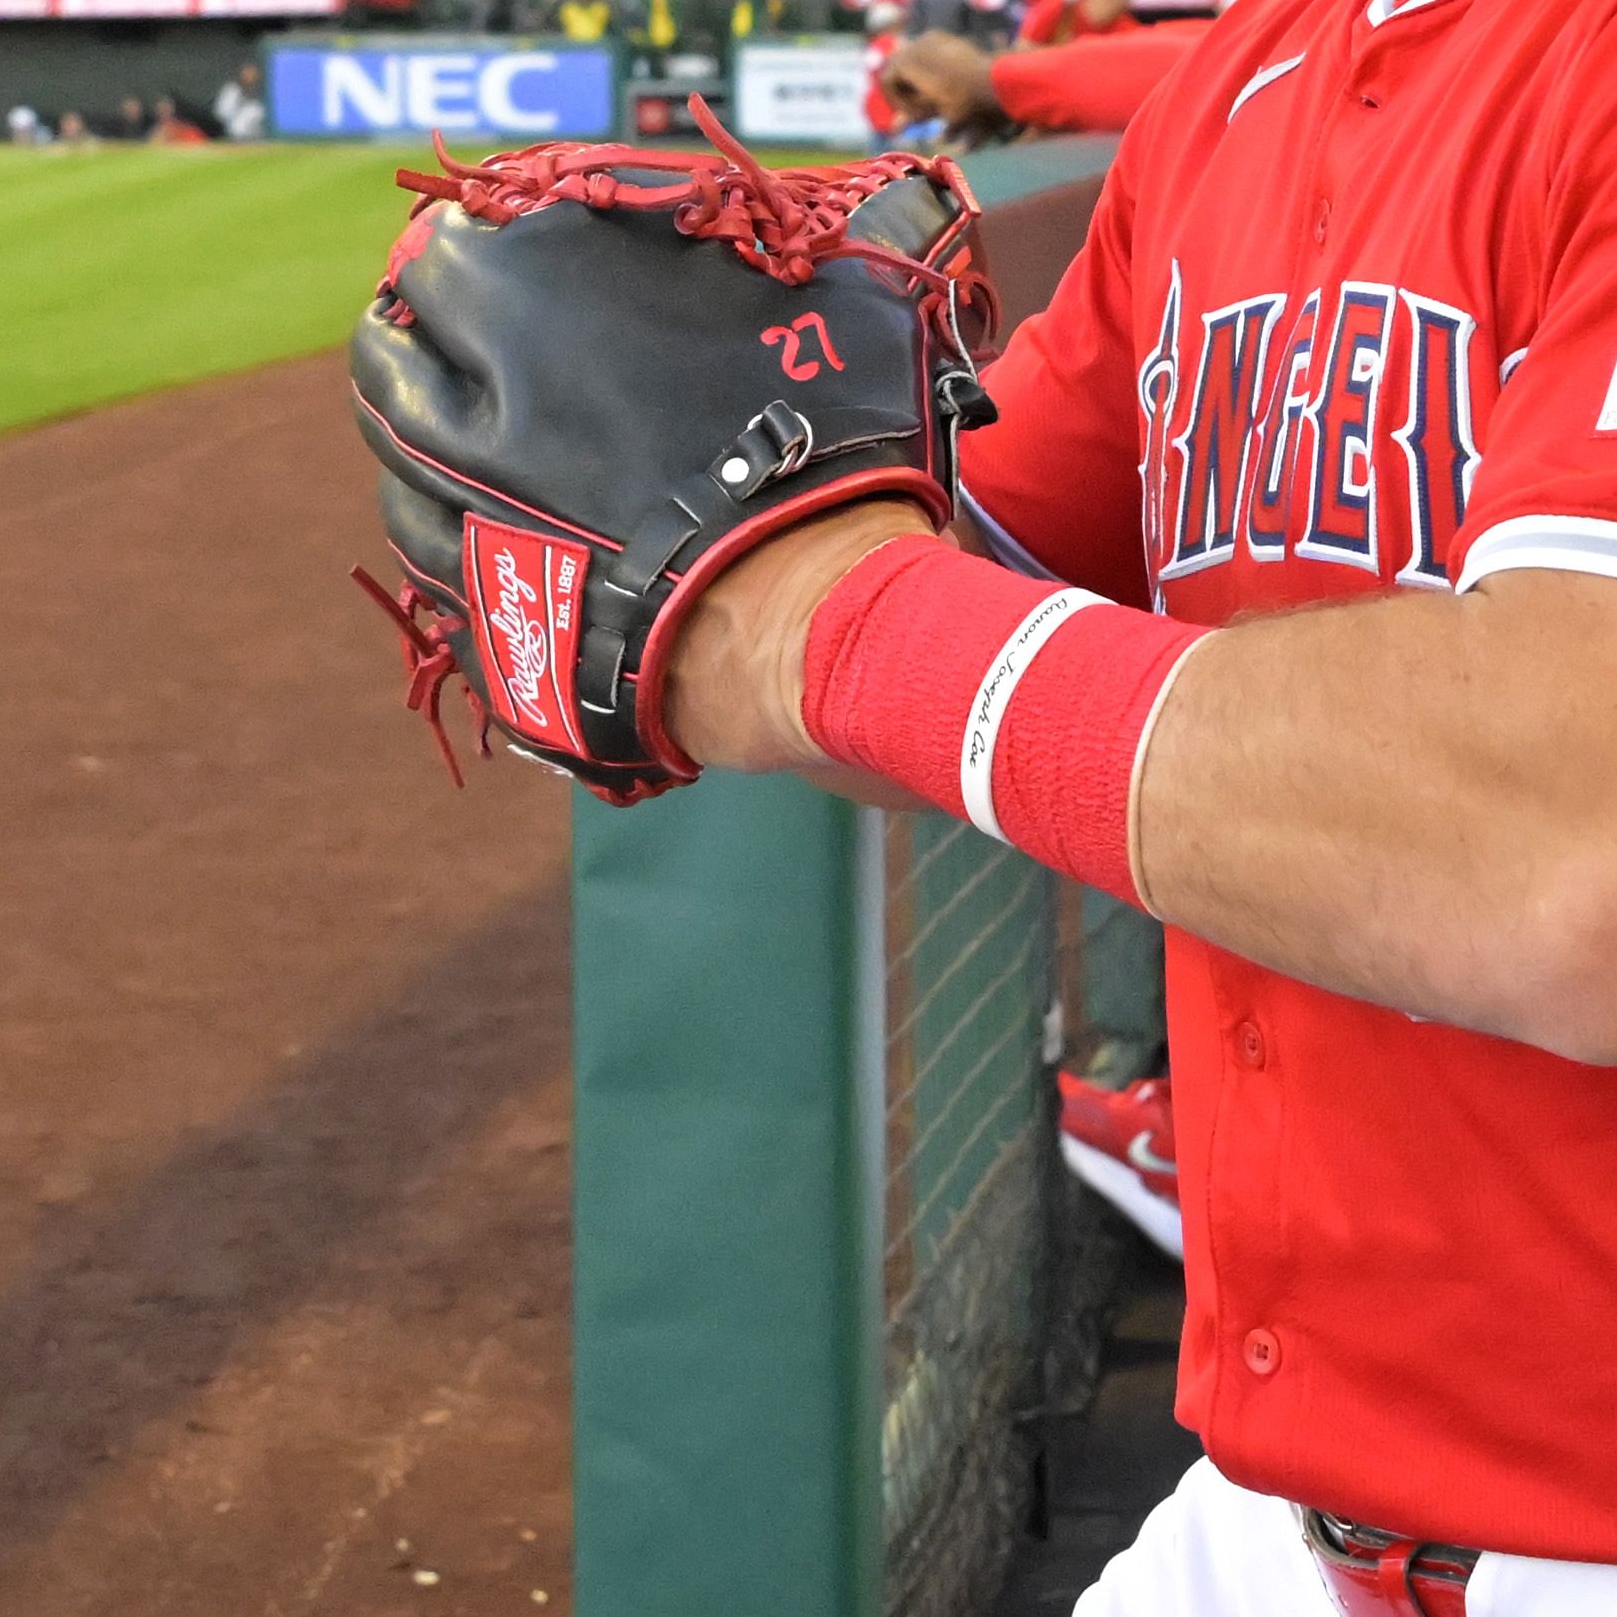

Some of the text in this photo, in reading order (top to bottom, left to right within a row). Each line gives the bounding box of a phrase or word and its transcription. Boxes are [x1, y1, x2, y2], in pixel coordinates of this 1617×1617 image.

[322, 53, 559, 131] NEC
[760, 310, 846, 382] 27
[556, 554, 577, 631] Est. 1887
[489, 546, 548, 727] Rawlings
[977, 650, 1017, 726] Joseph
